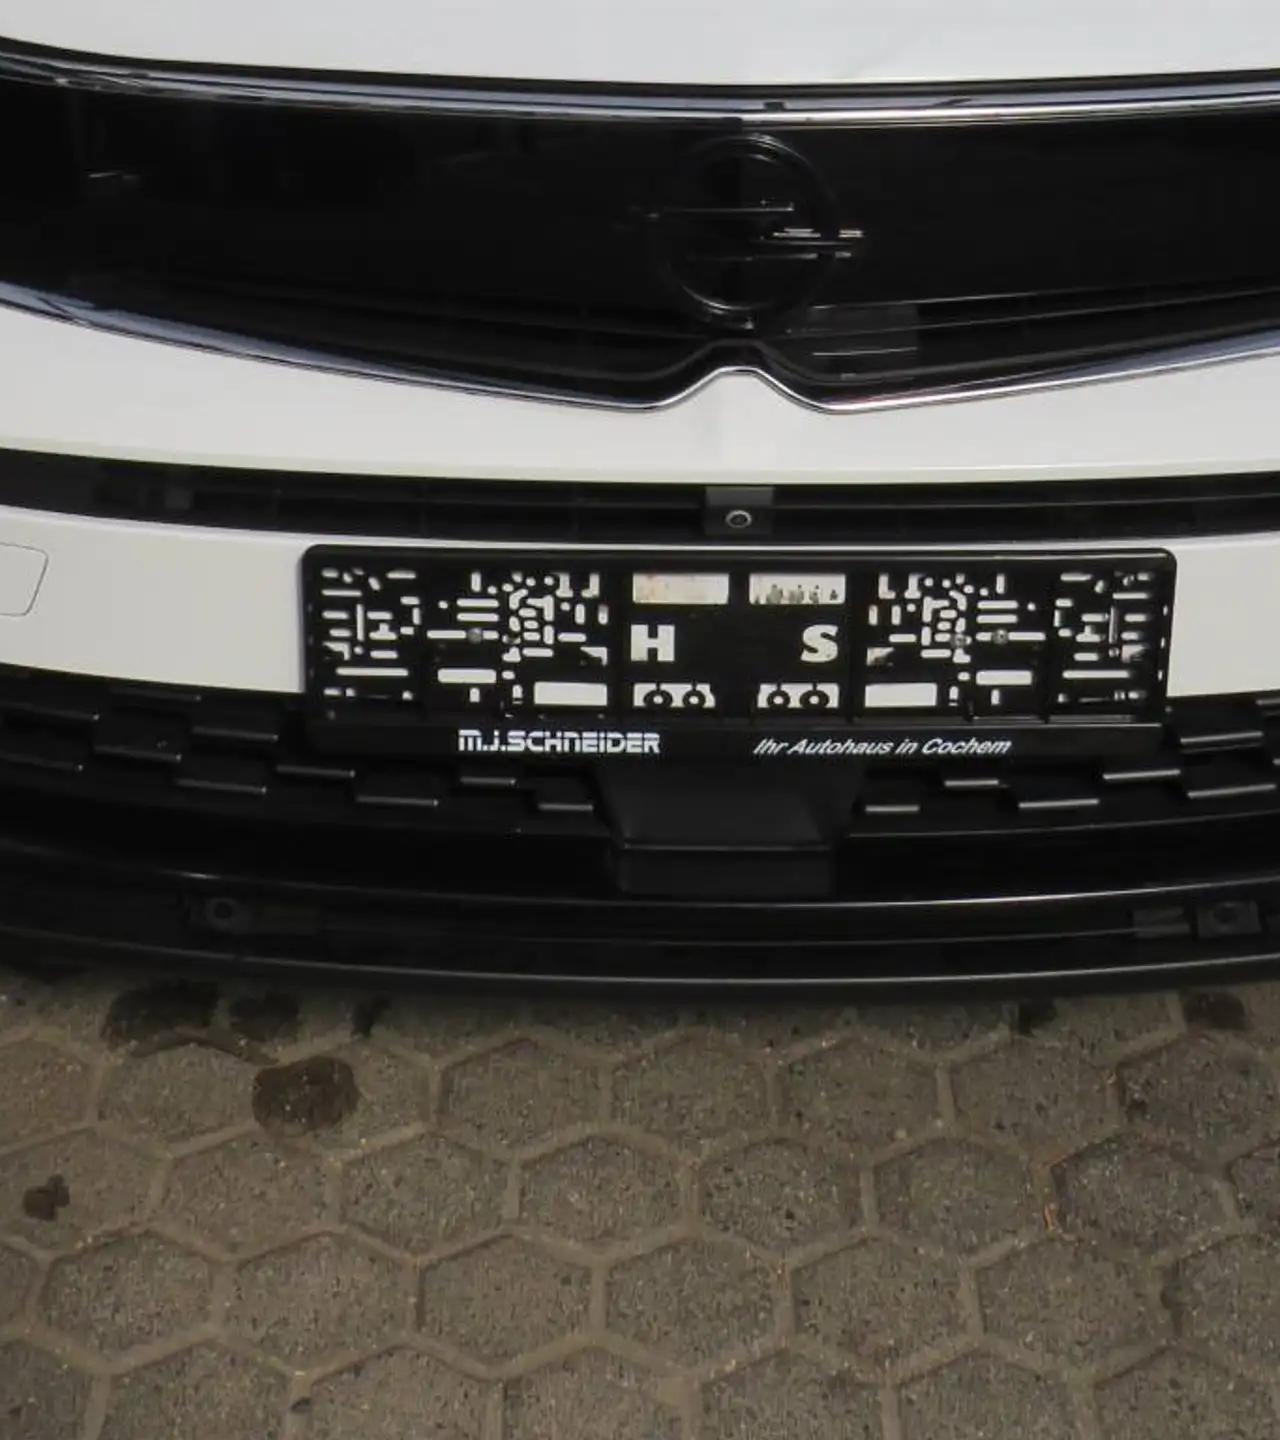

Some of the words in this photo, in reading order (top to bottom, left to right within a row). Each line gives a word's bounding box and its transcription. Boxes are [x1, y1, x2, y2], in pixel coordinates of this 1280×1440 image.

[753, 737, 789, 755] Ihr
[786, 738, 894, 756] Autohaus
[894, 738, 918, 755] in
[921, 737, 1012, 756] Cochem
